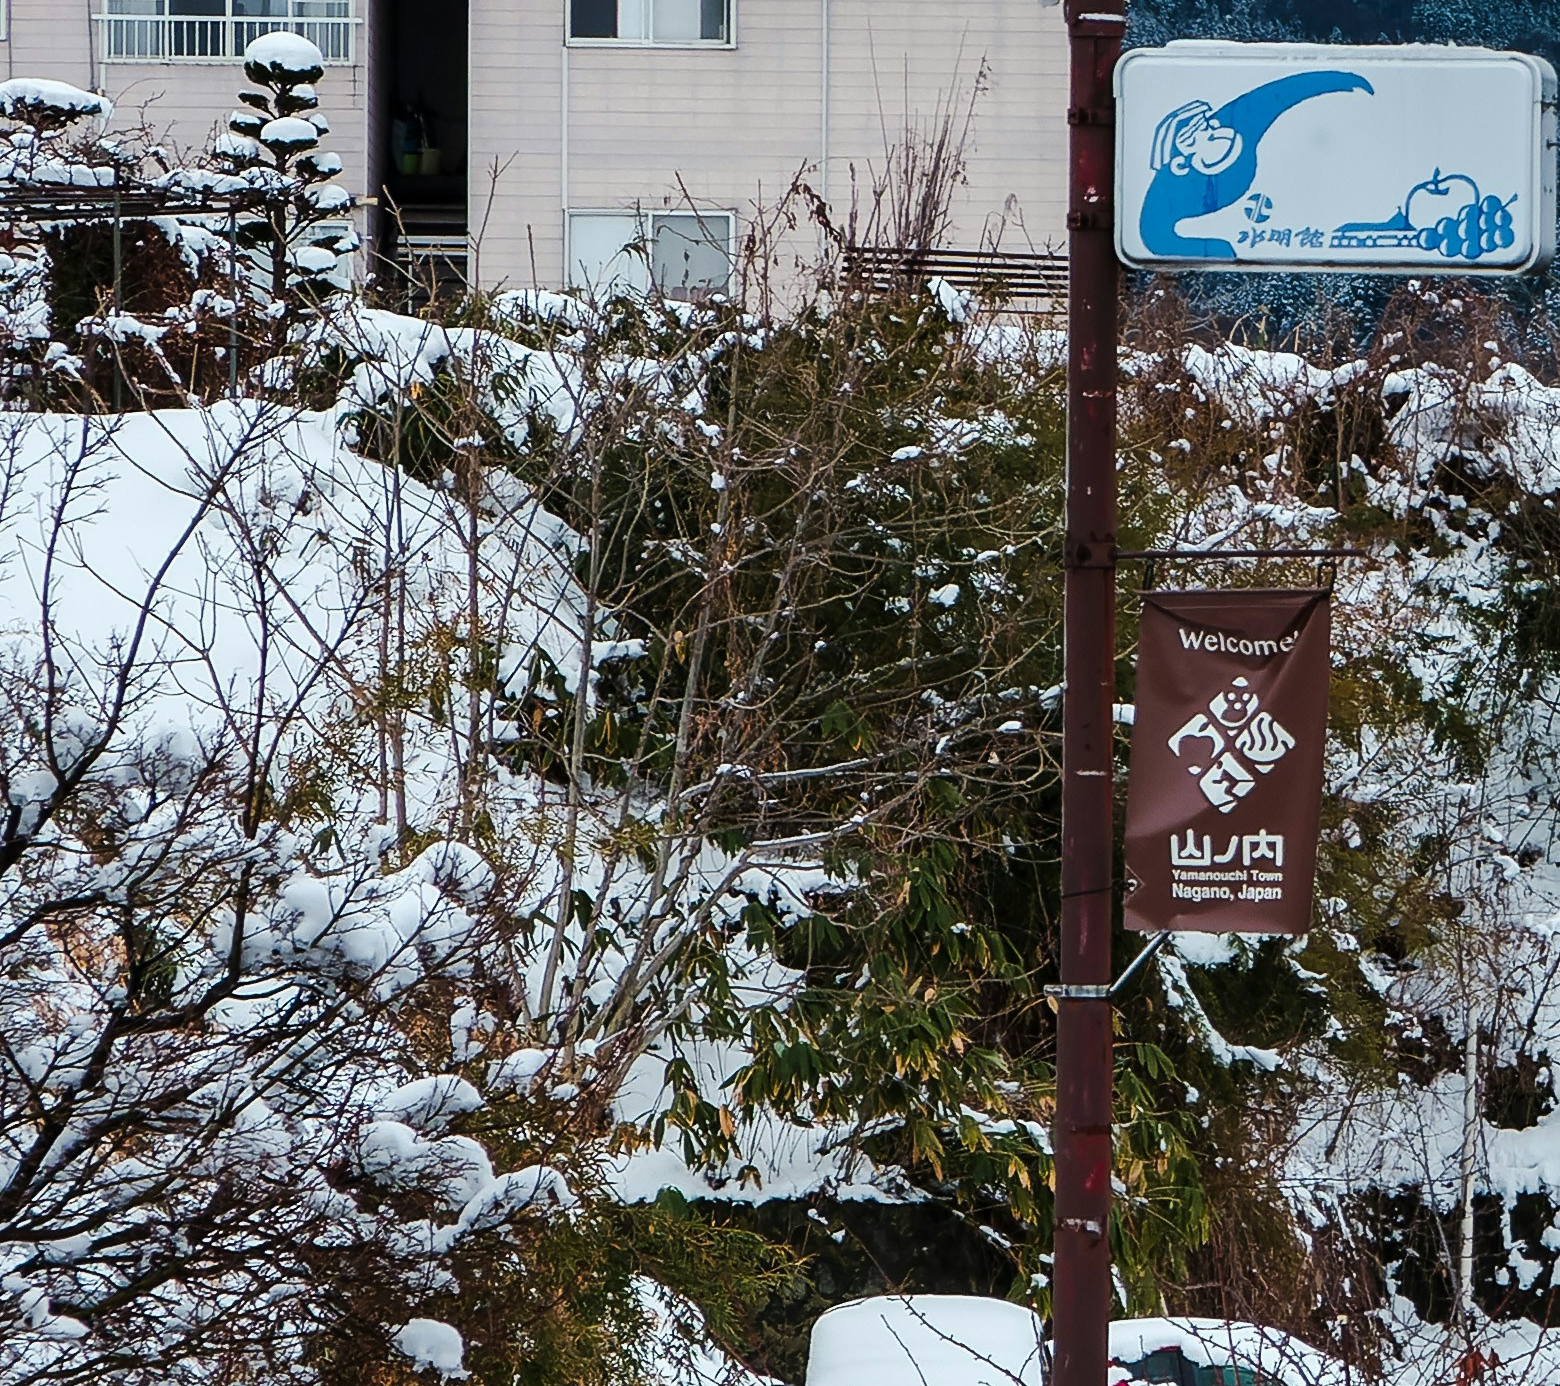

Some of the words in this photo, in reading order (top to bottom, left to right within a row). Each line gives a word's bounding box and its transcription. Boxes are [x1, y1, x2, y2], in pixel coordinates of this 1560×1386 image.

[1237, 226, 1325, 249] 水明館
[1170, 828, 1284, 868] 山ノ内
[1172, 869, 1248, 882] Yamanouchi
[1250, 869, 1283, 882] Town
[1172, 883, 1234, 902] Nagano,
[1238, 884, 1283, 903] Japan
